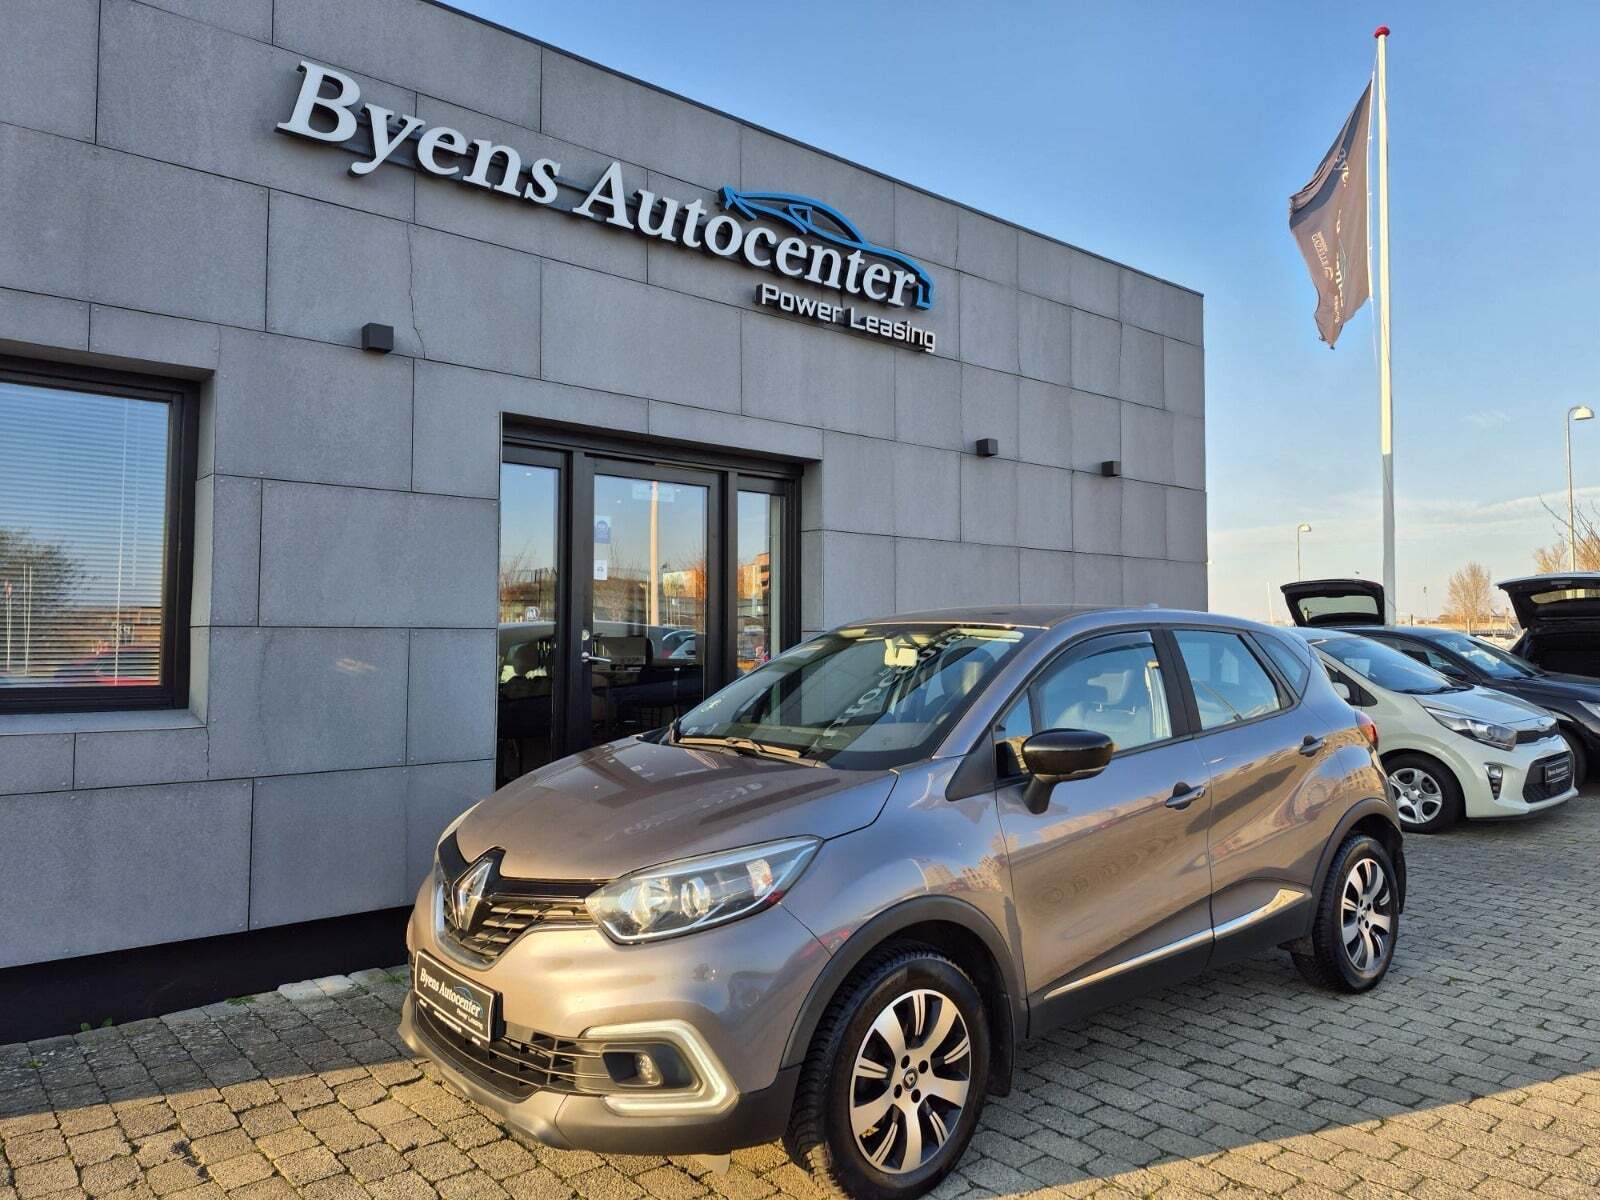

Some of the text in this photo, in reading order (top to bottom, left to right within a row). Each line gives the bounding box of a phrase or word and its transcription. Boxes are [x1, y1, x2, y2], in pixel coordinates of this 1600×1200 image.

[277, 61, 915, 307] Byens Autocenter
[761, 283, 936, 353] Power Leasing
[420, 967, 482, 1018] Byens Autocenter
